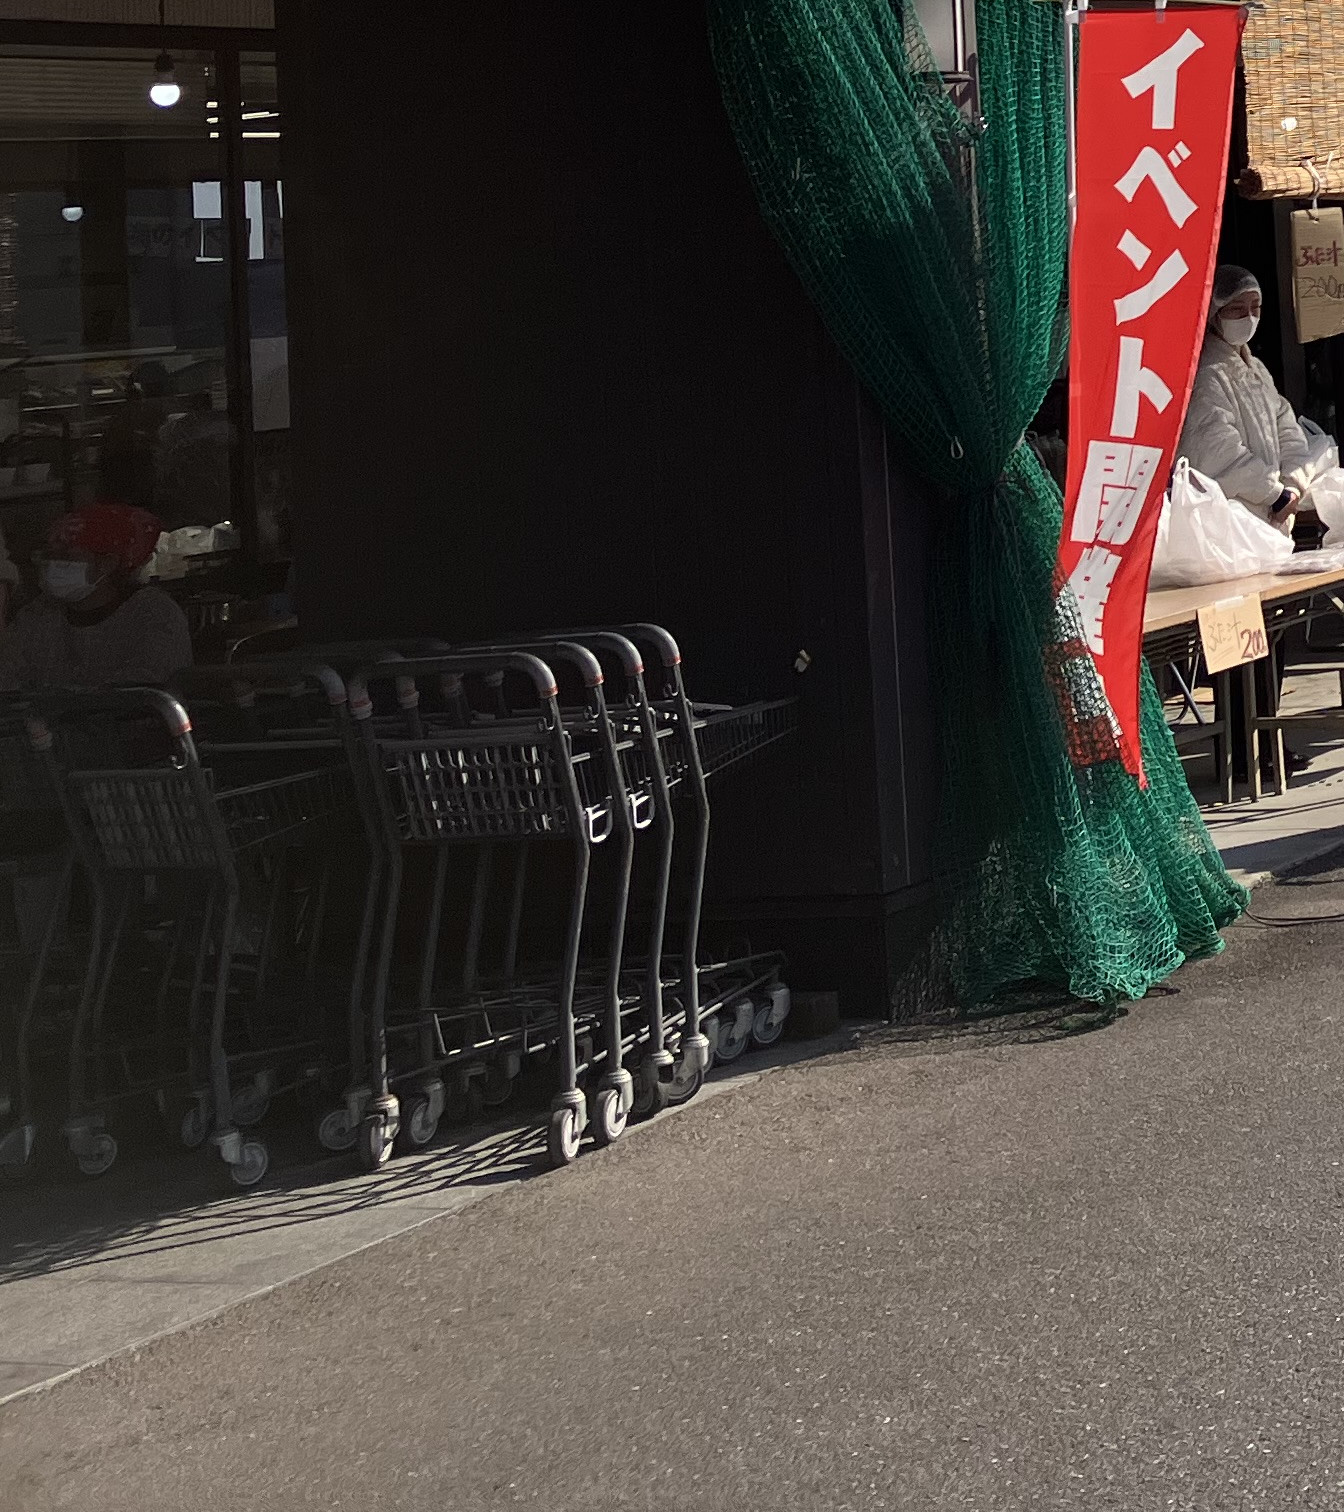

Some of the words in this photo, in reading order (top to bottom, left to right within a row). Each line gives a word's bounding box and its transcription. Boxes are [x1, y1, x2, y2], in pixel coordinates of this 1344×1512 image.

[1055, 26, 1204, 740] イベント開催
